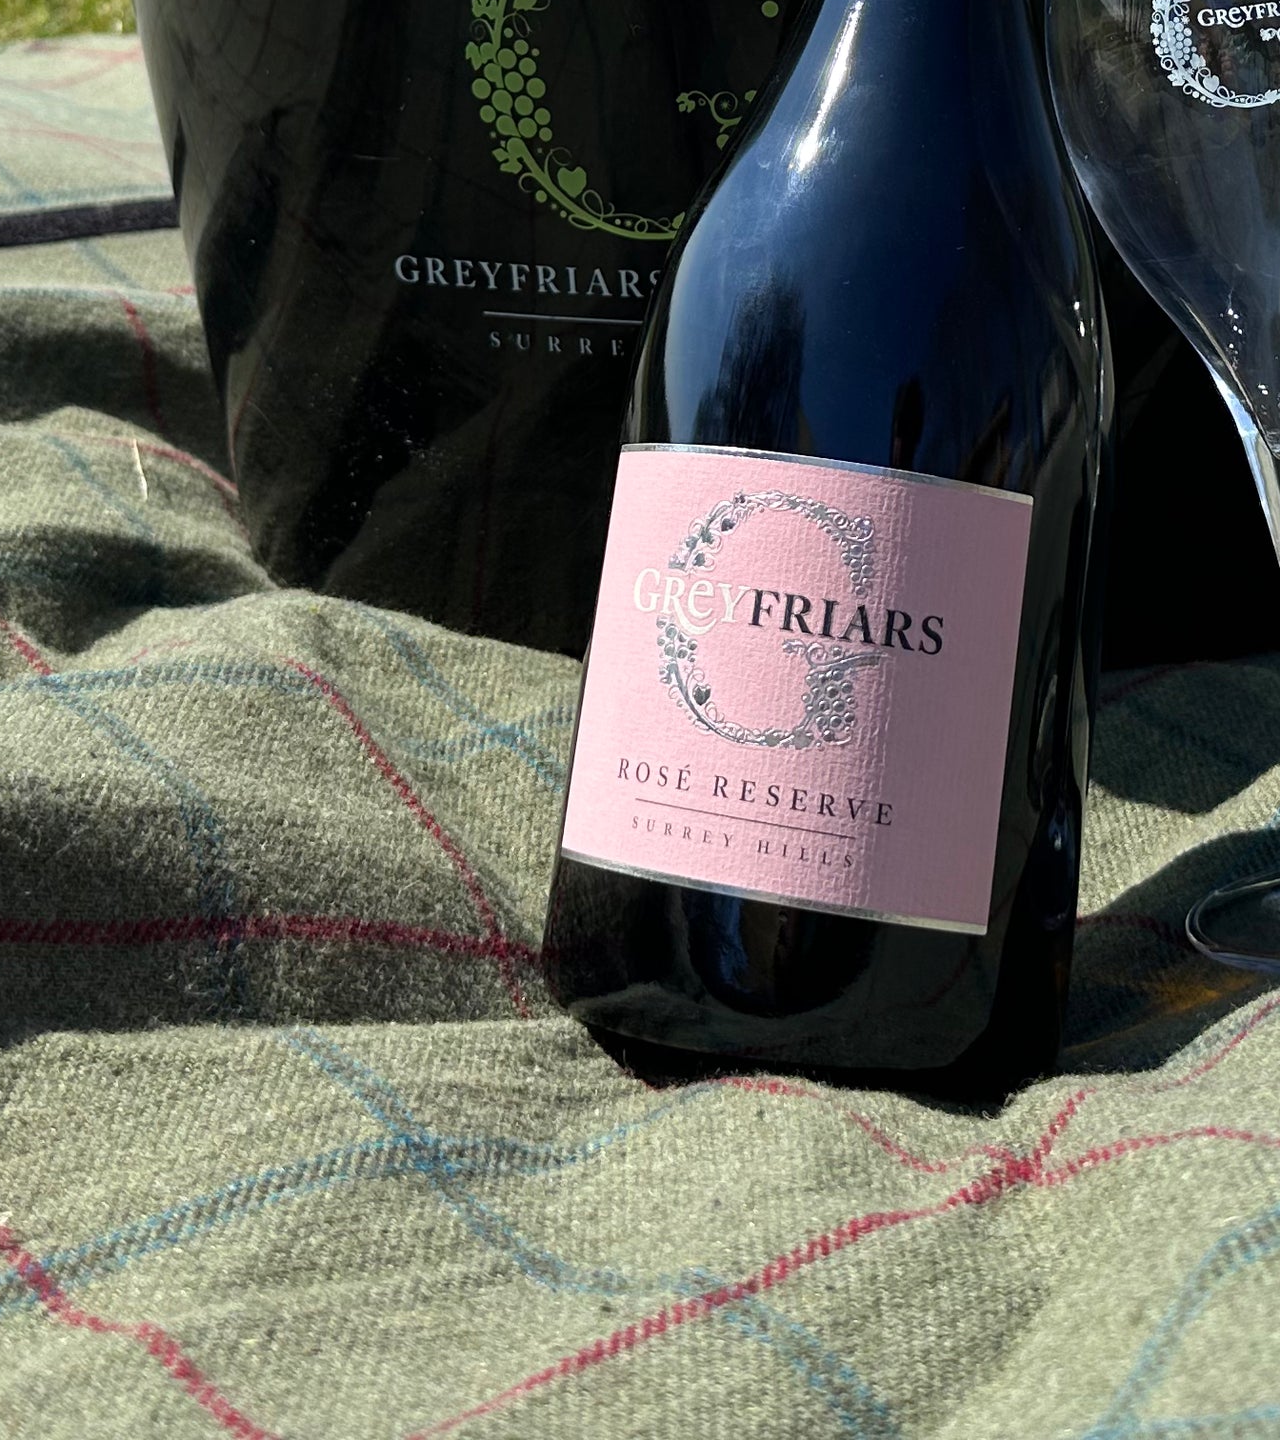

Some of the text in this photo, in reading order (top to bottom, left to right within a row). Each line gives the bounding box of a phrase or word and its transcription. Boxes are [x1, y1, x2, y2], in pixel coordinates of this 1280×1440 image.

[489, 330, 625, 357] SURRE
[617, 758, 894, 826] ROSÉ RESERVE
[631, 815, 855, 868] SURREY HILLS
